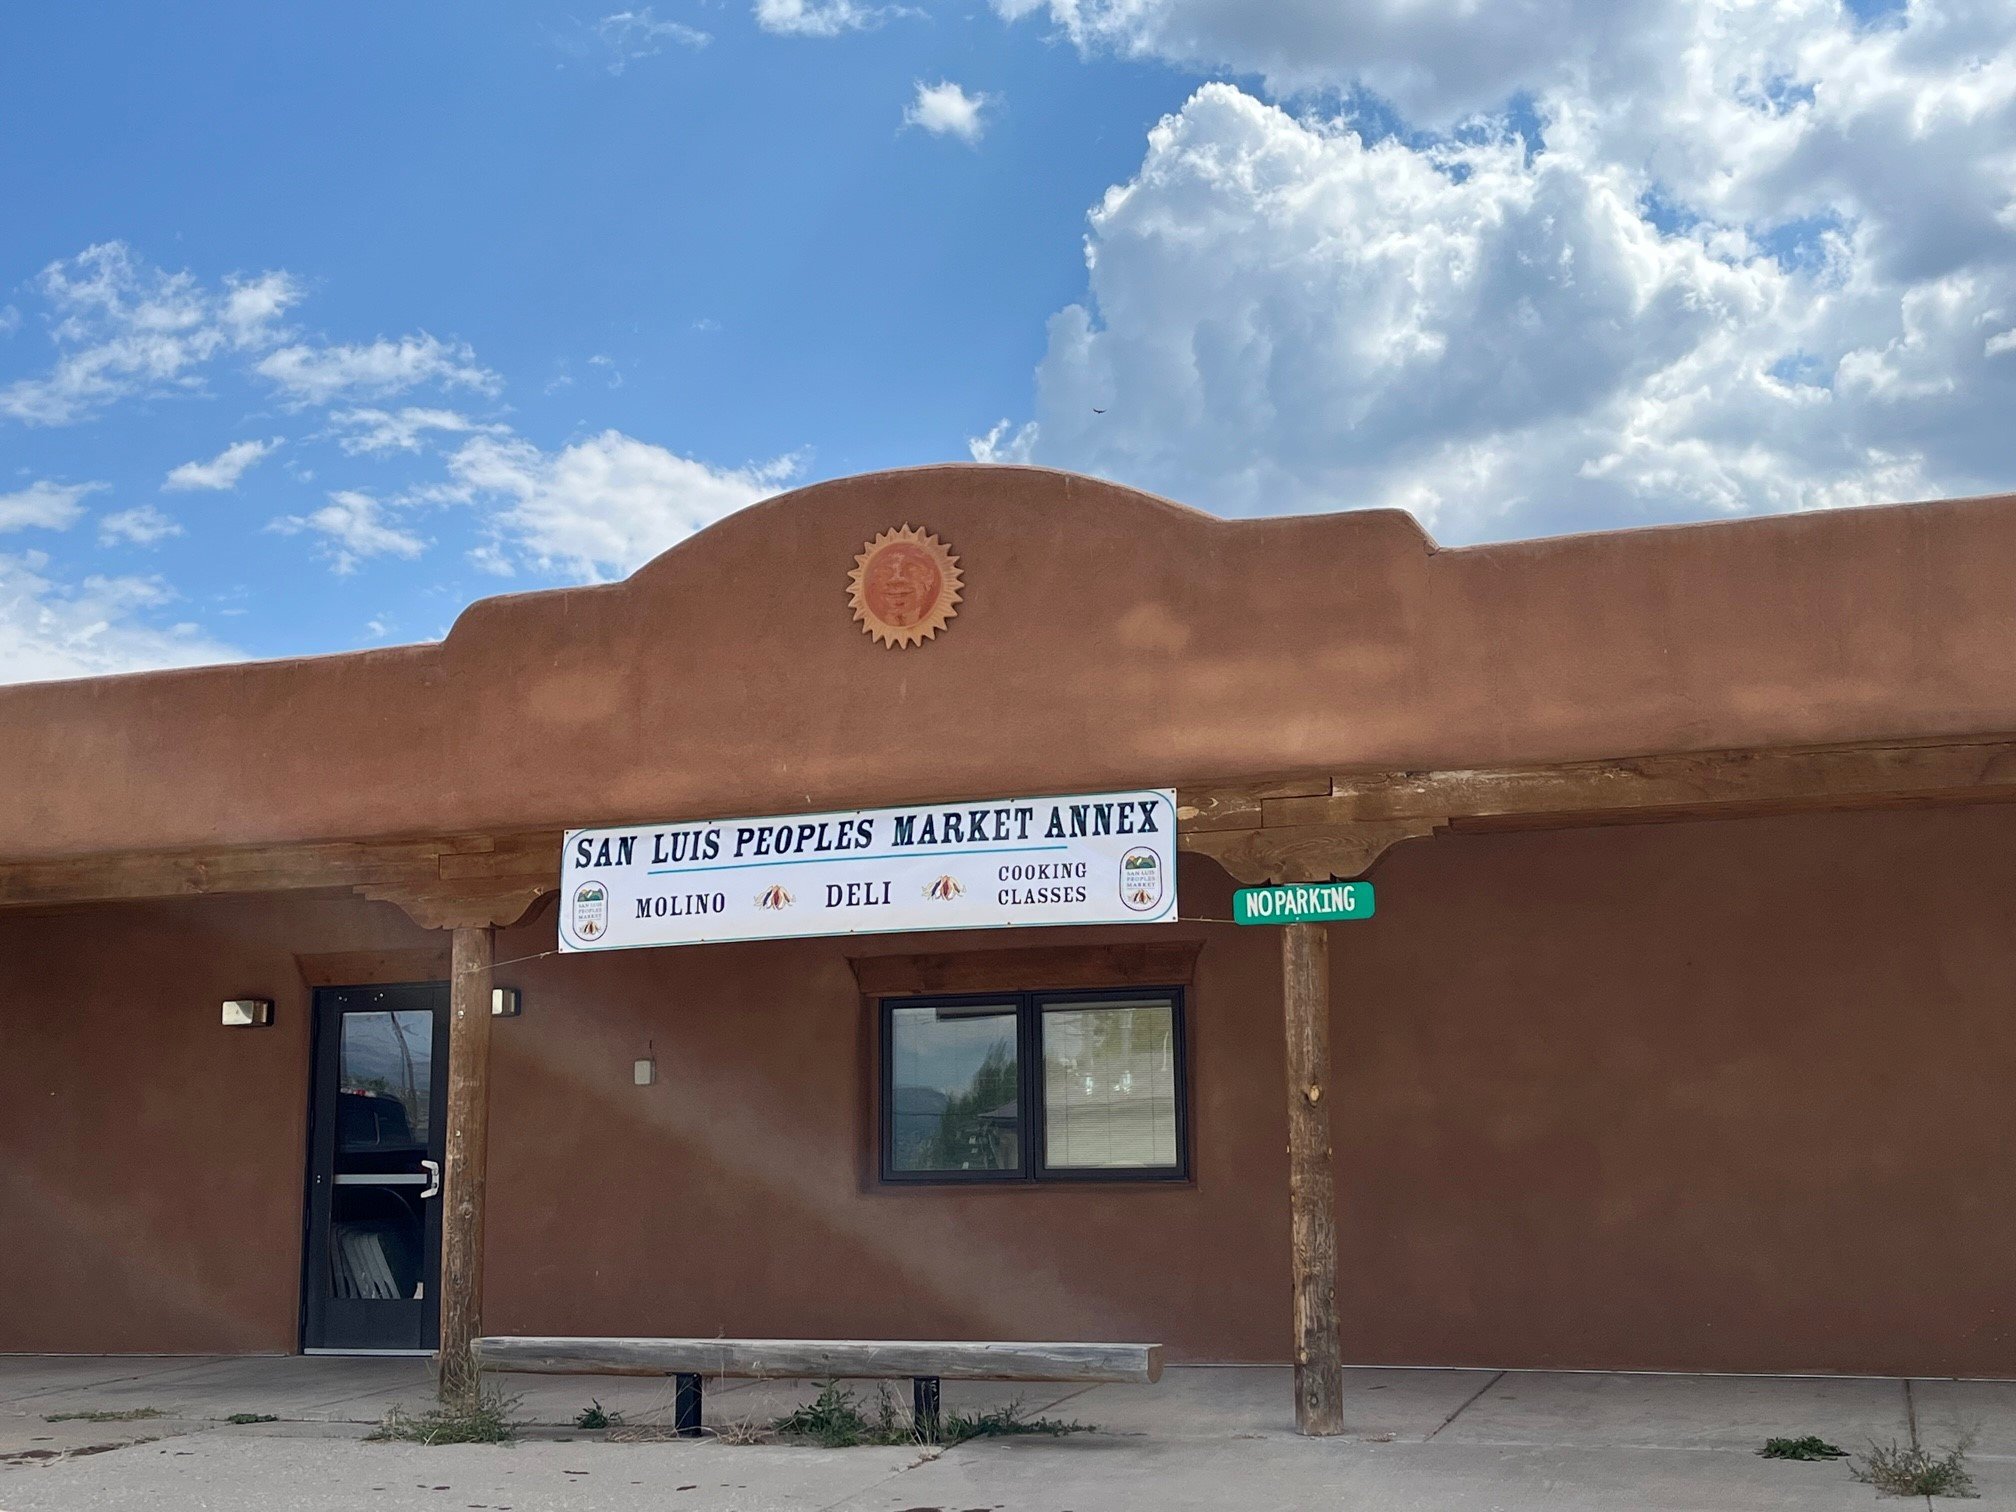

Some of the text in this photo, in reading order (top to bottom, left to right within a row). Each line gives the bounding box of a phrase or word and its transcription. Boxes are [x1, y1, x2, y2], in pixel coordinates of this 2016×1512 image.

[575, 800, 1159, 869] SAN LUIS PEOPLES MARKET ANNEX
[998, 862, 1087, 881] COOKING
[635, 881, 892, 919] MOLINO DELI
[997, 886, 1087, 905] CLASSES
[1246, 885, 1356, 917] NO PARKING
